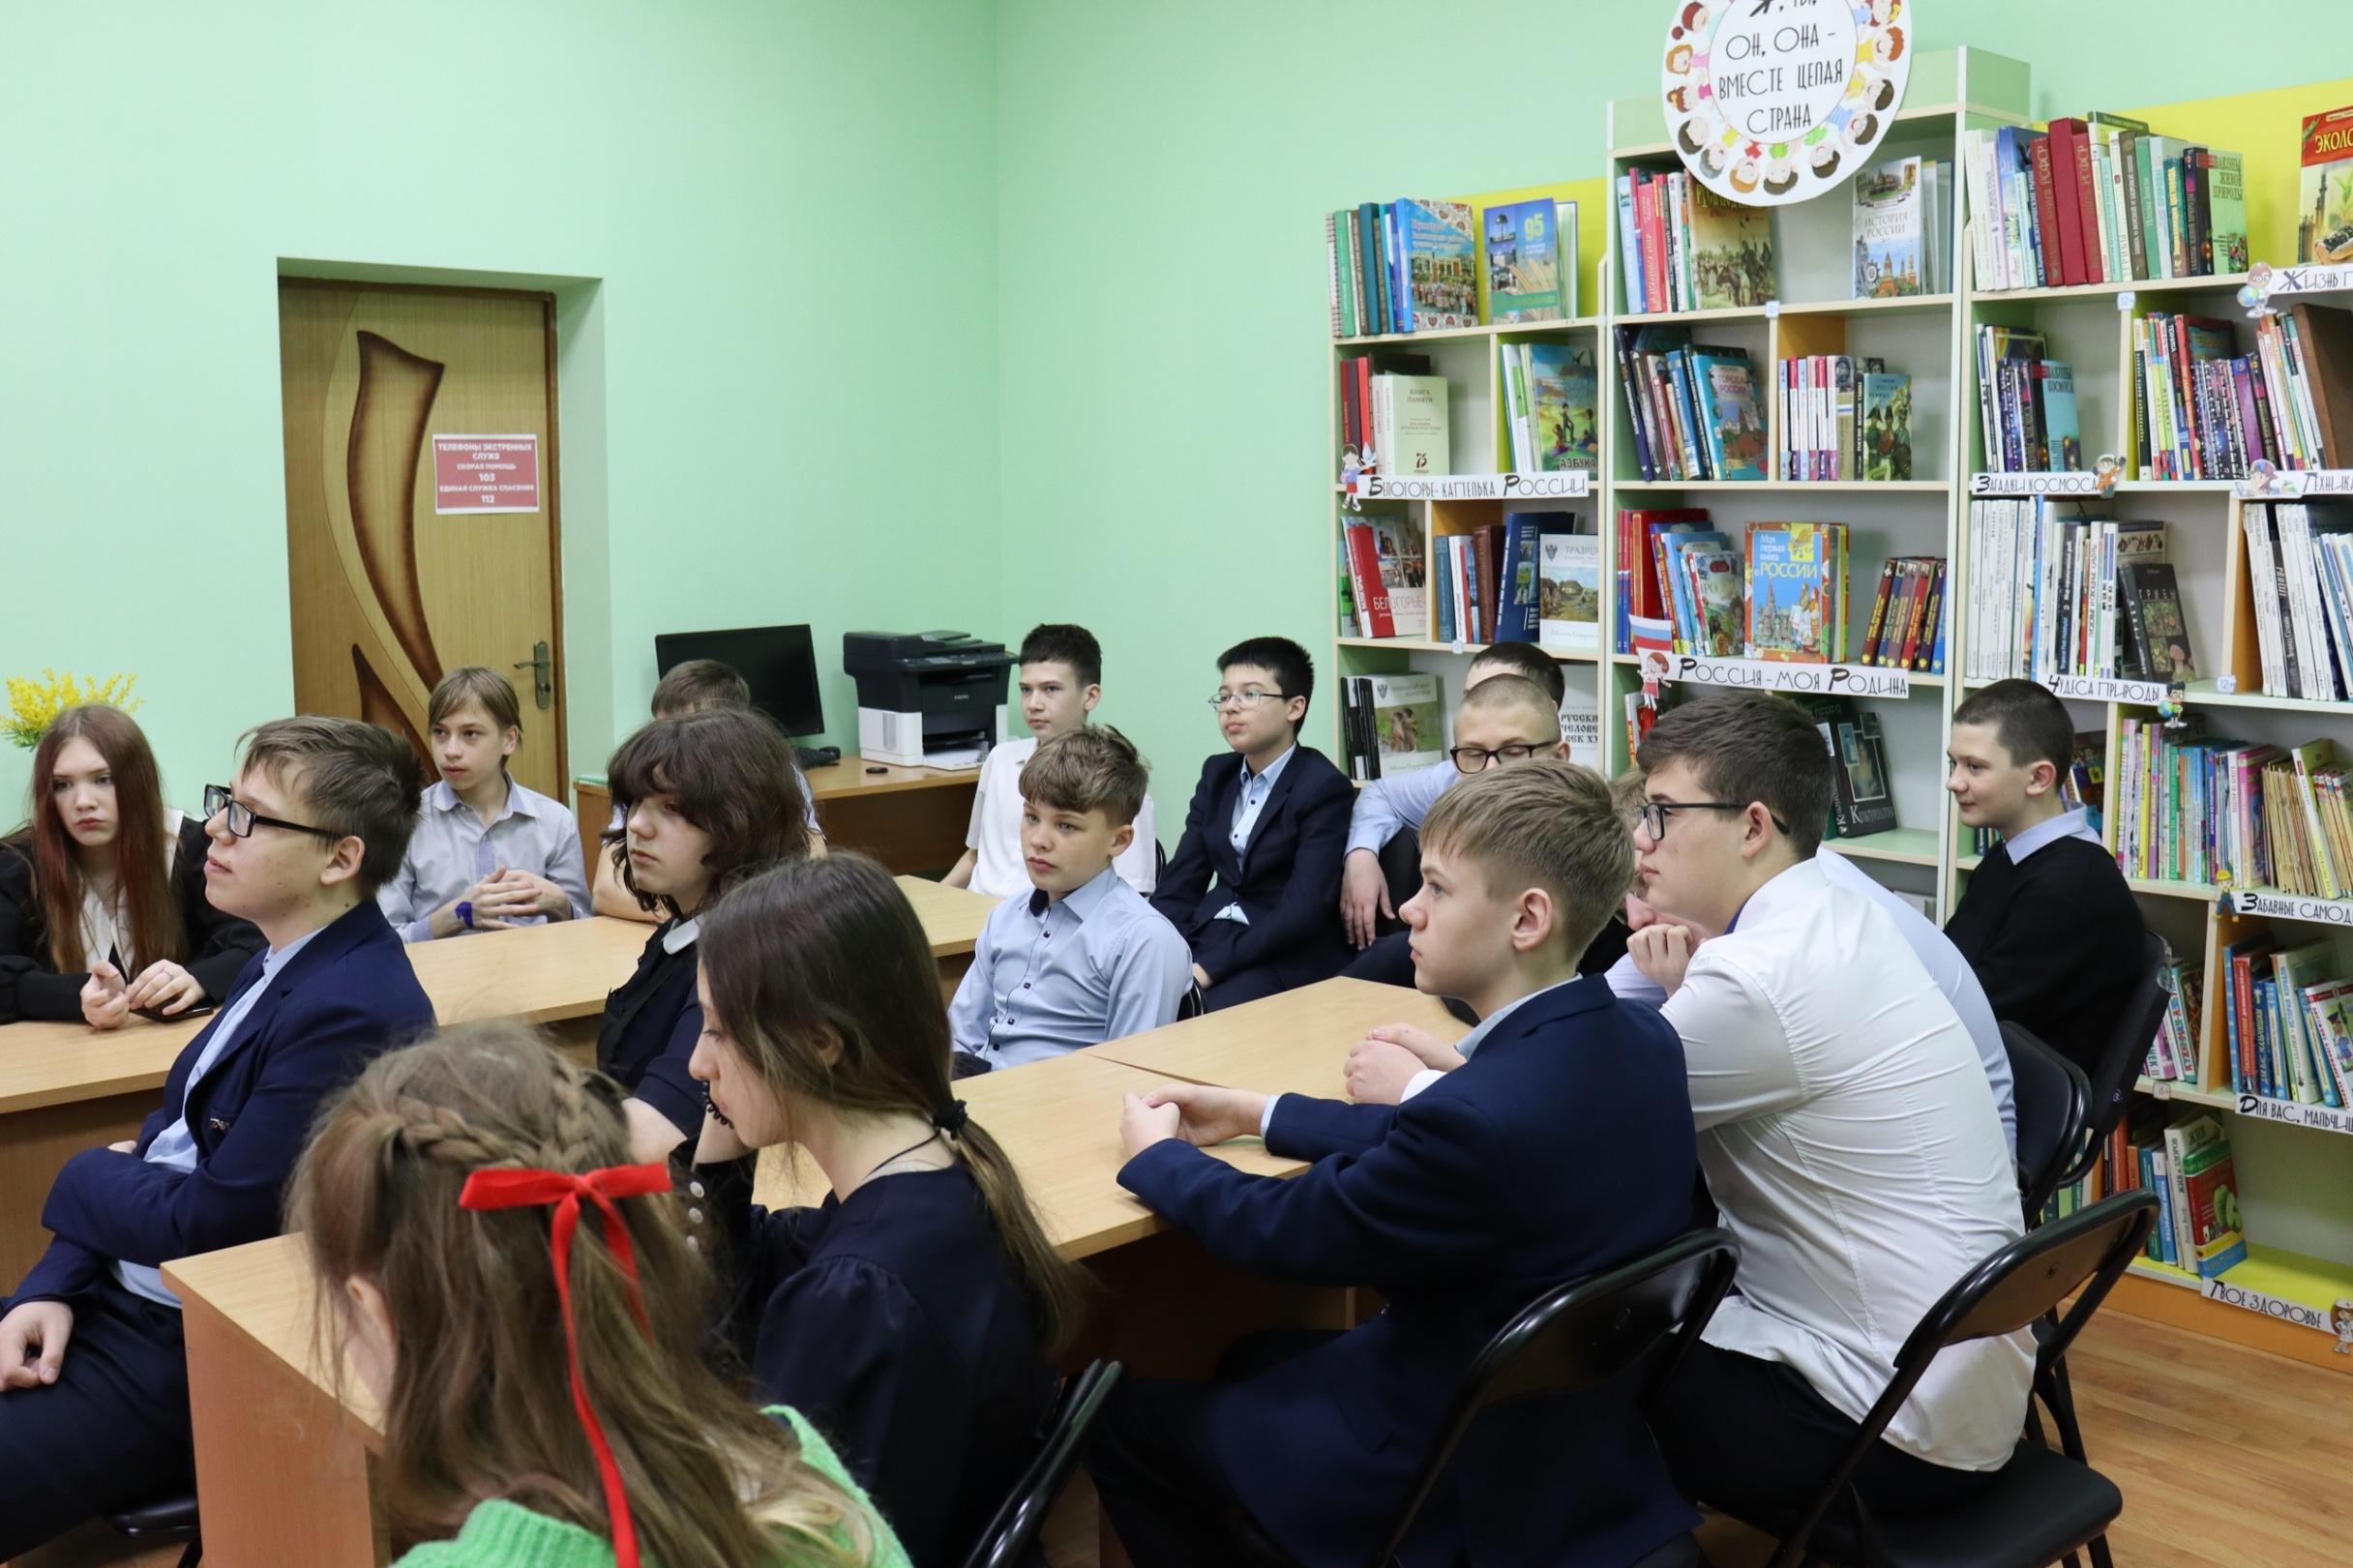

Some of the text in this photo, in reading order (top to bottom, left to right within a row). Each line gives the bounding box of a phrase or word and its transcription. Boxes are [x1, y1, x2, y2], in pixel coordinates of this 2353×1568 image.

[1726, 32, 1766, 60] ОН,
[1774, 23, 1819, 52] ОНА
[1719, 68, 1783, 100] ВМЕСТЕ
[1746, 104, 1812, 133] СТРАНА
[1864, 212, 1908, 227] ИСТОРИЯ
[1867, 223, 1905, 238] РОССИИ
[2278, 270, 2338, 291] ЖИЗНЬ
[1560, 457, 1596, 469] АЗБУКА
[479, 473, 495, 482] 103
[1504, 474, 1586, 496] РОССИИ
[1977, 475, 2098, 493] ЗАГАДКИ КОСМОСА
[1761, 533, 1776, 543] Моя
[1761, 545, 1786, 554] первая
[1761, 562, 1818, 578] РОССИИ
[1373, 596, 1424, 610] БЕЛОГОРЬЕ
[1679, 657, 1762, 686] РОССИЯ
[1775, 670, 1820, 691] МОЯ
[1829, 667, 1907, 695] РОДИНА
[2048, 674, 2159, 702] ЧУДЕСА ПРИРОДЫ
[2241, 893, 2353, 924] ЗАБАВНЫЕ САМОД
[2240, 1095, 2267, 1115] ДЛЯ
[2211, 1280, 2321, 1328] ТВОЕ ЗДОРОВЬЕ
